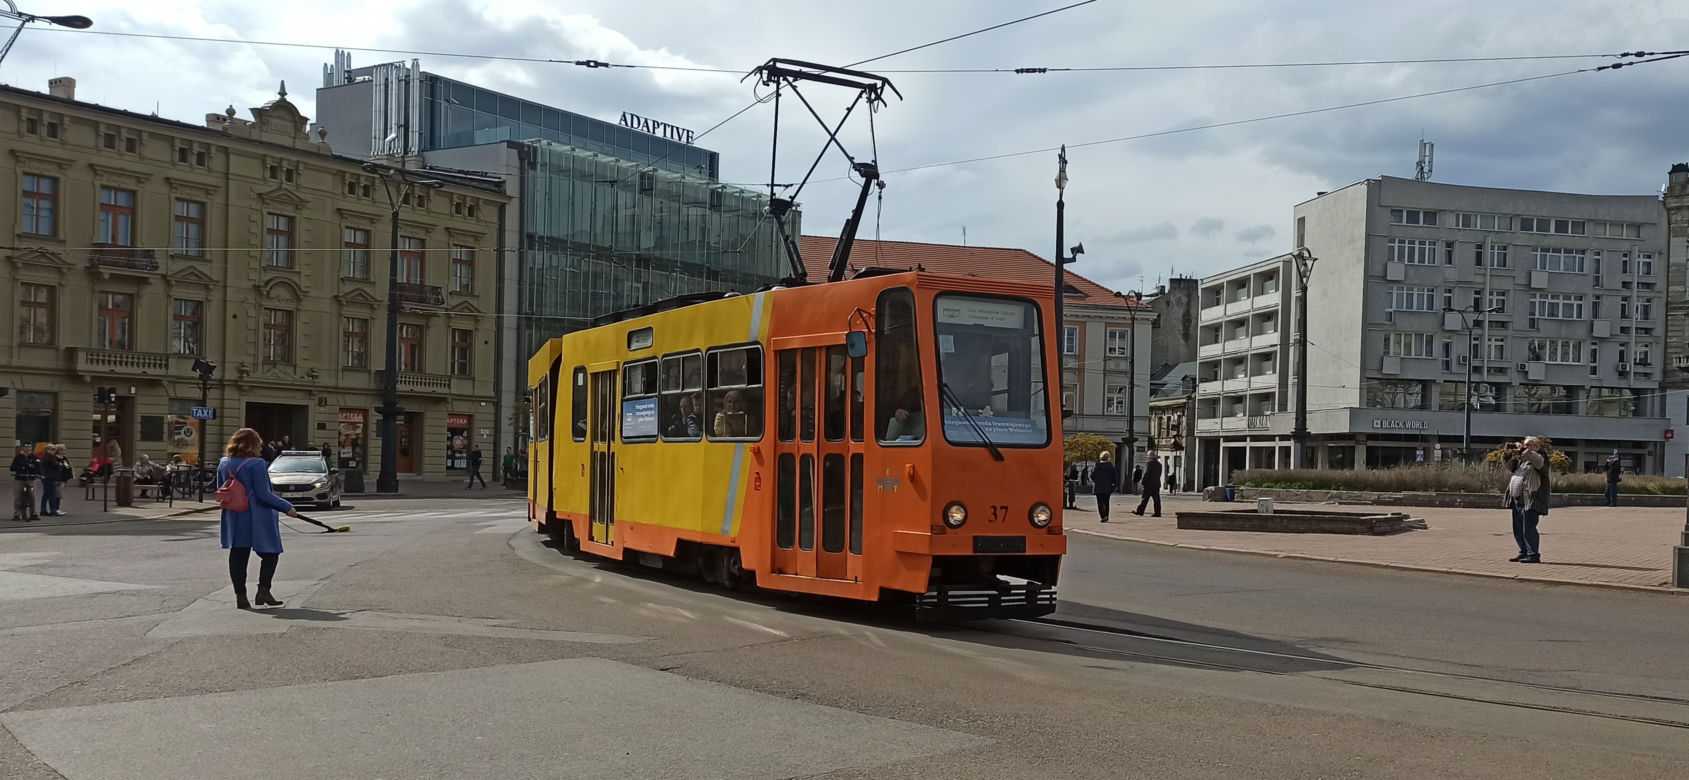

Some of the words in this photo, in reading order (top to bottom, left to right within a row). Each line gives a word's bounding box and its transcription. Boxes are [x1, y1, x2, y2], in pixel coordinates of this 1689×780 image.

[619, 111, 695, 145] ADAPTIVE
[191, 408, 212, 418] TAXI
[1382, 420, 1404, 428] BLACK
[1405, 421, 1428, 429] WORLD
[987, 505, 1009, 523] 37
